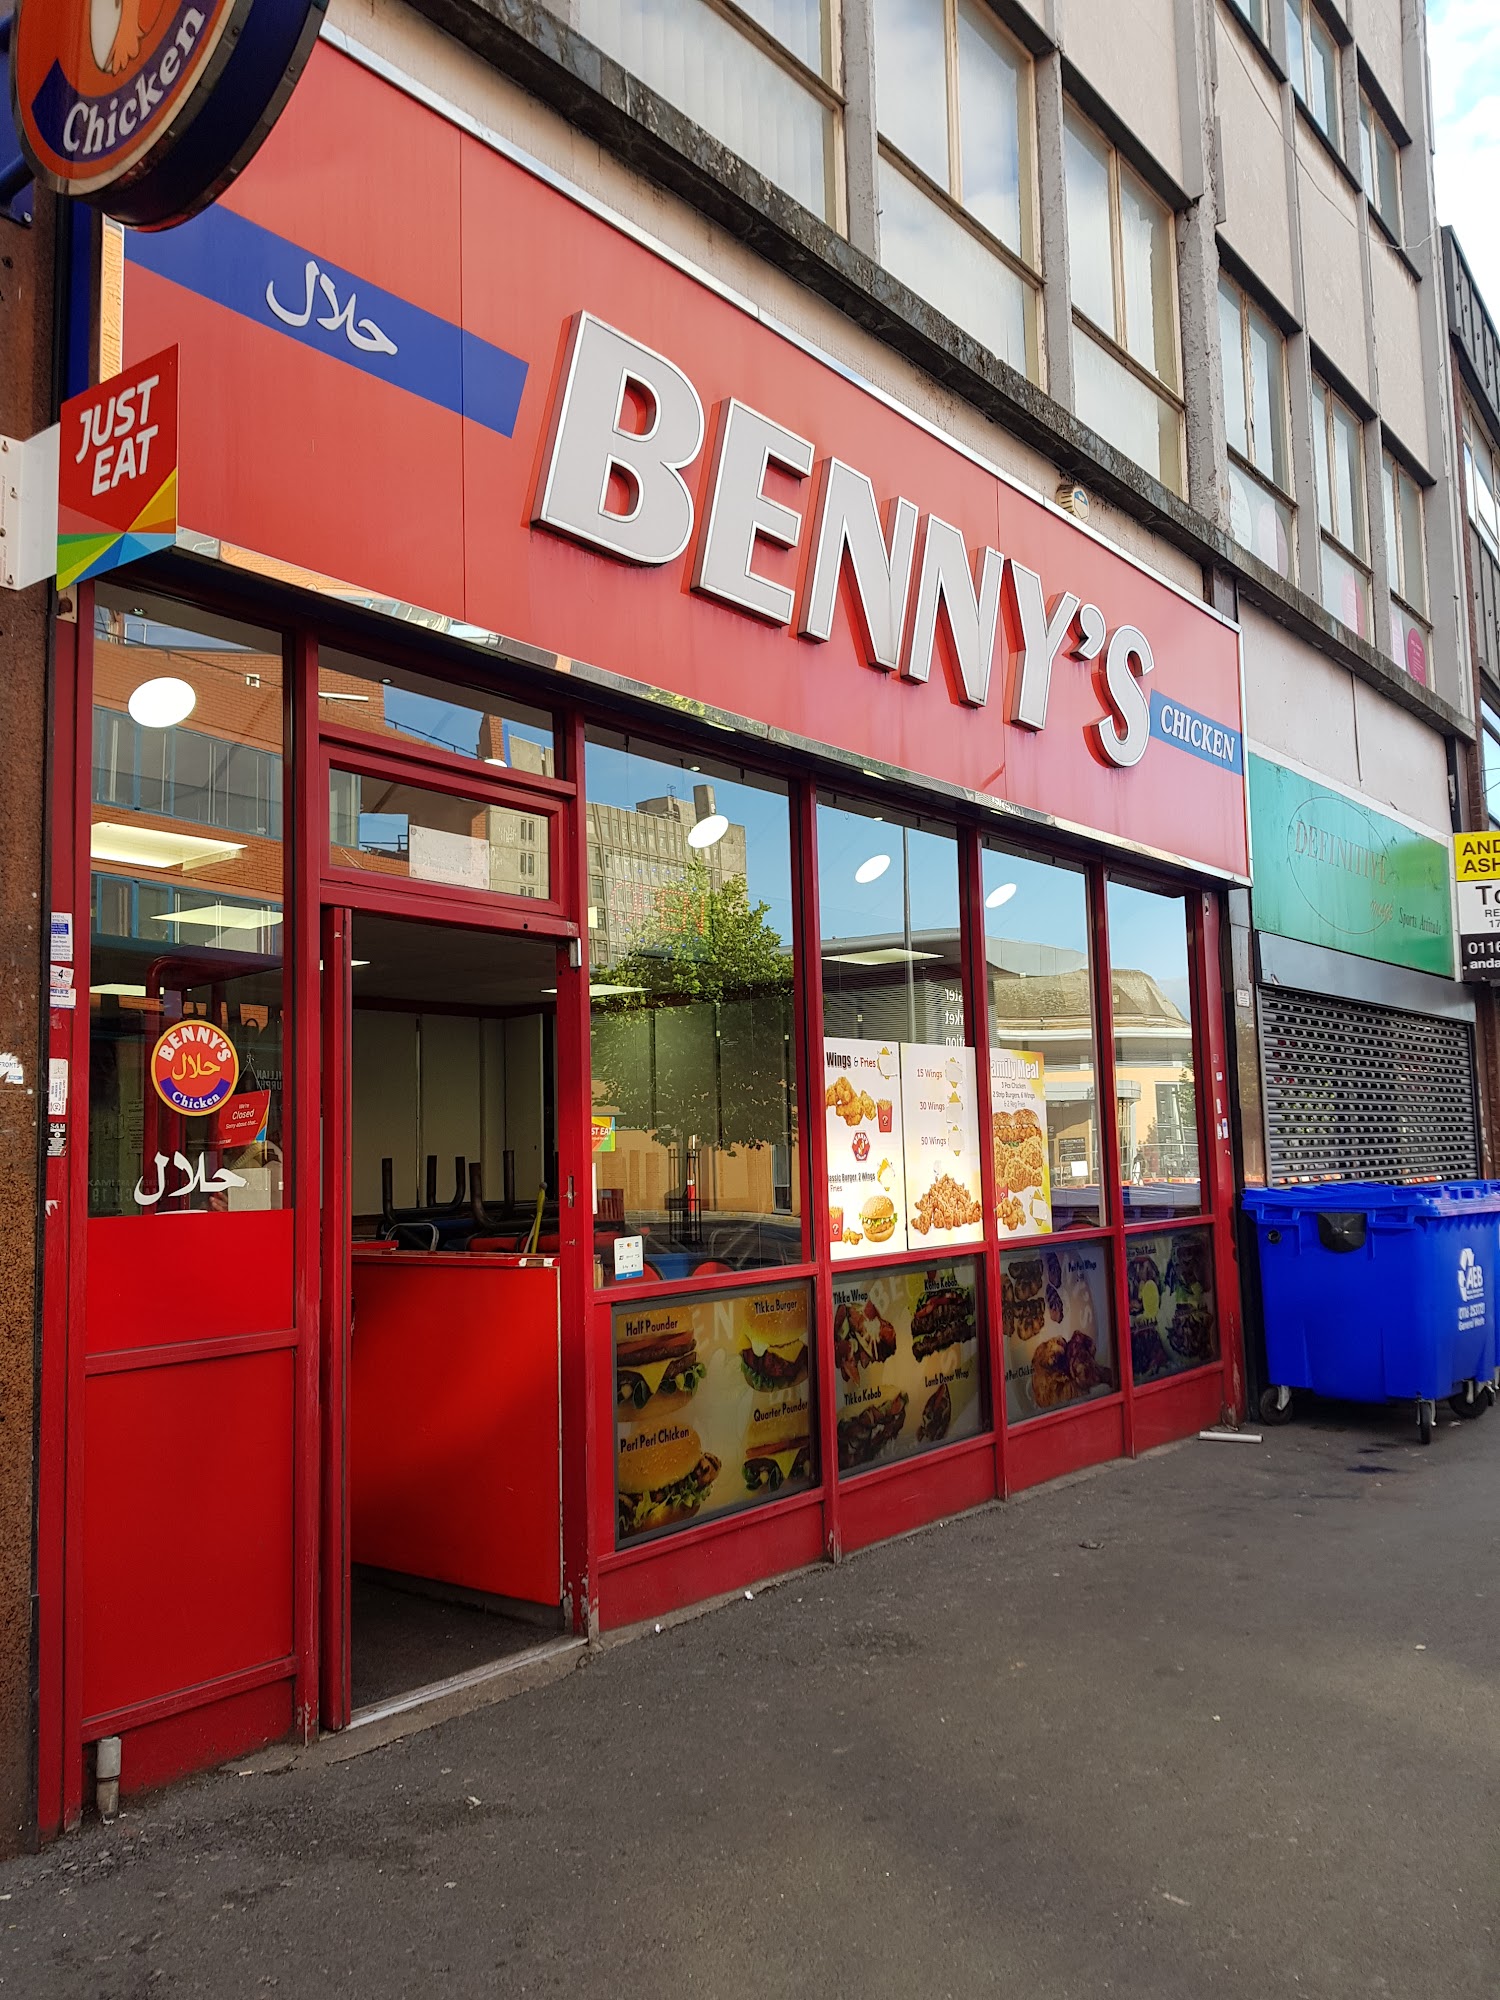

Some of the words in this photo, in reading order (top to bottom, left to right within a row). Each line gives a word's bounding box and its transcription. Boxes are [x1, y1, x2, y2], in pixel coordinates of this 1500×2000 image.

[63, 7, 206, 155] Chicken
[265, 260, 398, 356] حلال
[75, 374, 159, 464] JUST
[92, 424, 159, 496] EAT
[531, 310, 1155, 768] BENNY'S
[1160, 704, 1235, 763] CHICKEN
[1295, 820, 1387, 885] DEFINITIVE
[611, 880, 704, 935] OPEN
[1399, 906, 1417, 929] Sports
[158, 1026, 231, 1062] BENNY'S
[172, 1052, 220, 1080] حلال
[826, 1052, 851, 1070] Wings
[860, 1057, 876, 1068] Fries
[1017, 1059, 1040, 1080] Meal
[917, 1068, 924, 1078] 15
[925, 1069, 942, 1080] Wings
[172, 1090, 220, 1109] Chicken
[920, 1102, 927, 1110] 30
[928, 1102, 945, 1112] Wings
[232, 1108, 255, 1120] Closed
[921, 1136, 928, 1145] 50
[929, 1137, 946, 1146] Wings
[134, 1151, 247, 1206] حلال
[862, 1172, 875, 1182] Wings
[940, 1277, 958, 1288] Kebab
[754, 1301, 774, 1315] Tikka
[775, 1300, 797, 1311] Burger
[833, 1291, 850, 1304] Tikka
[851, 1289, 868, 1302] Wrap
[626, 1320, 644, 1336] Half
[646, 1316, 678, 1333] Pounder
[925, 1373, 938, 1387] Lamb
[955, 1367, 969, 1379] Wrap
[844, 1392, 861, 1406] Tikka
[862, 1386, 882, 1400] Kebab
[754, 1408, 781, 1422] Quarter
[782, 1399, 808, 1415] Pounder
[620, 1437, 638, 1454] Peri
[640, 1434, 656, 1450] Peri
[658, 1427, 689, 1443] Chicken
